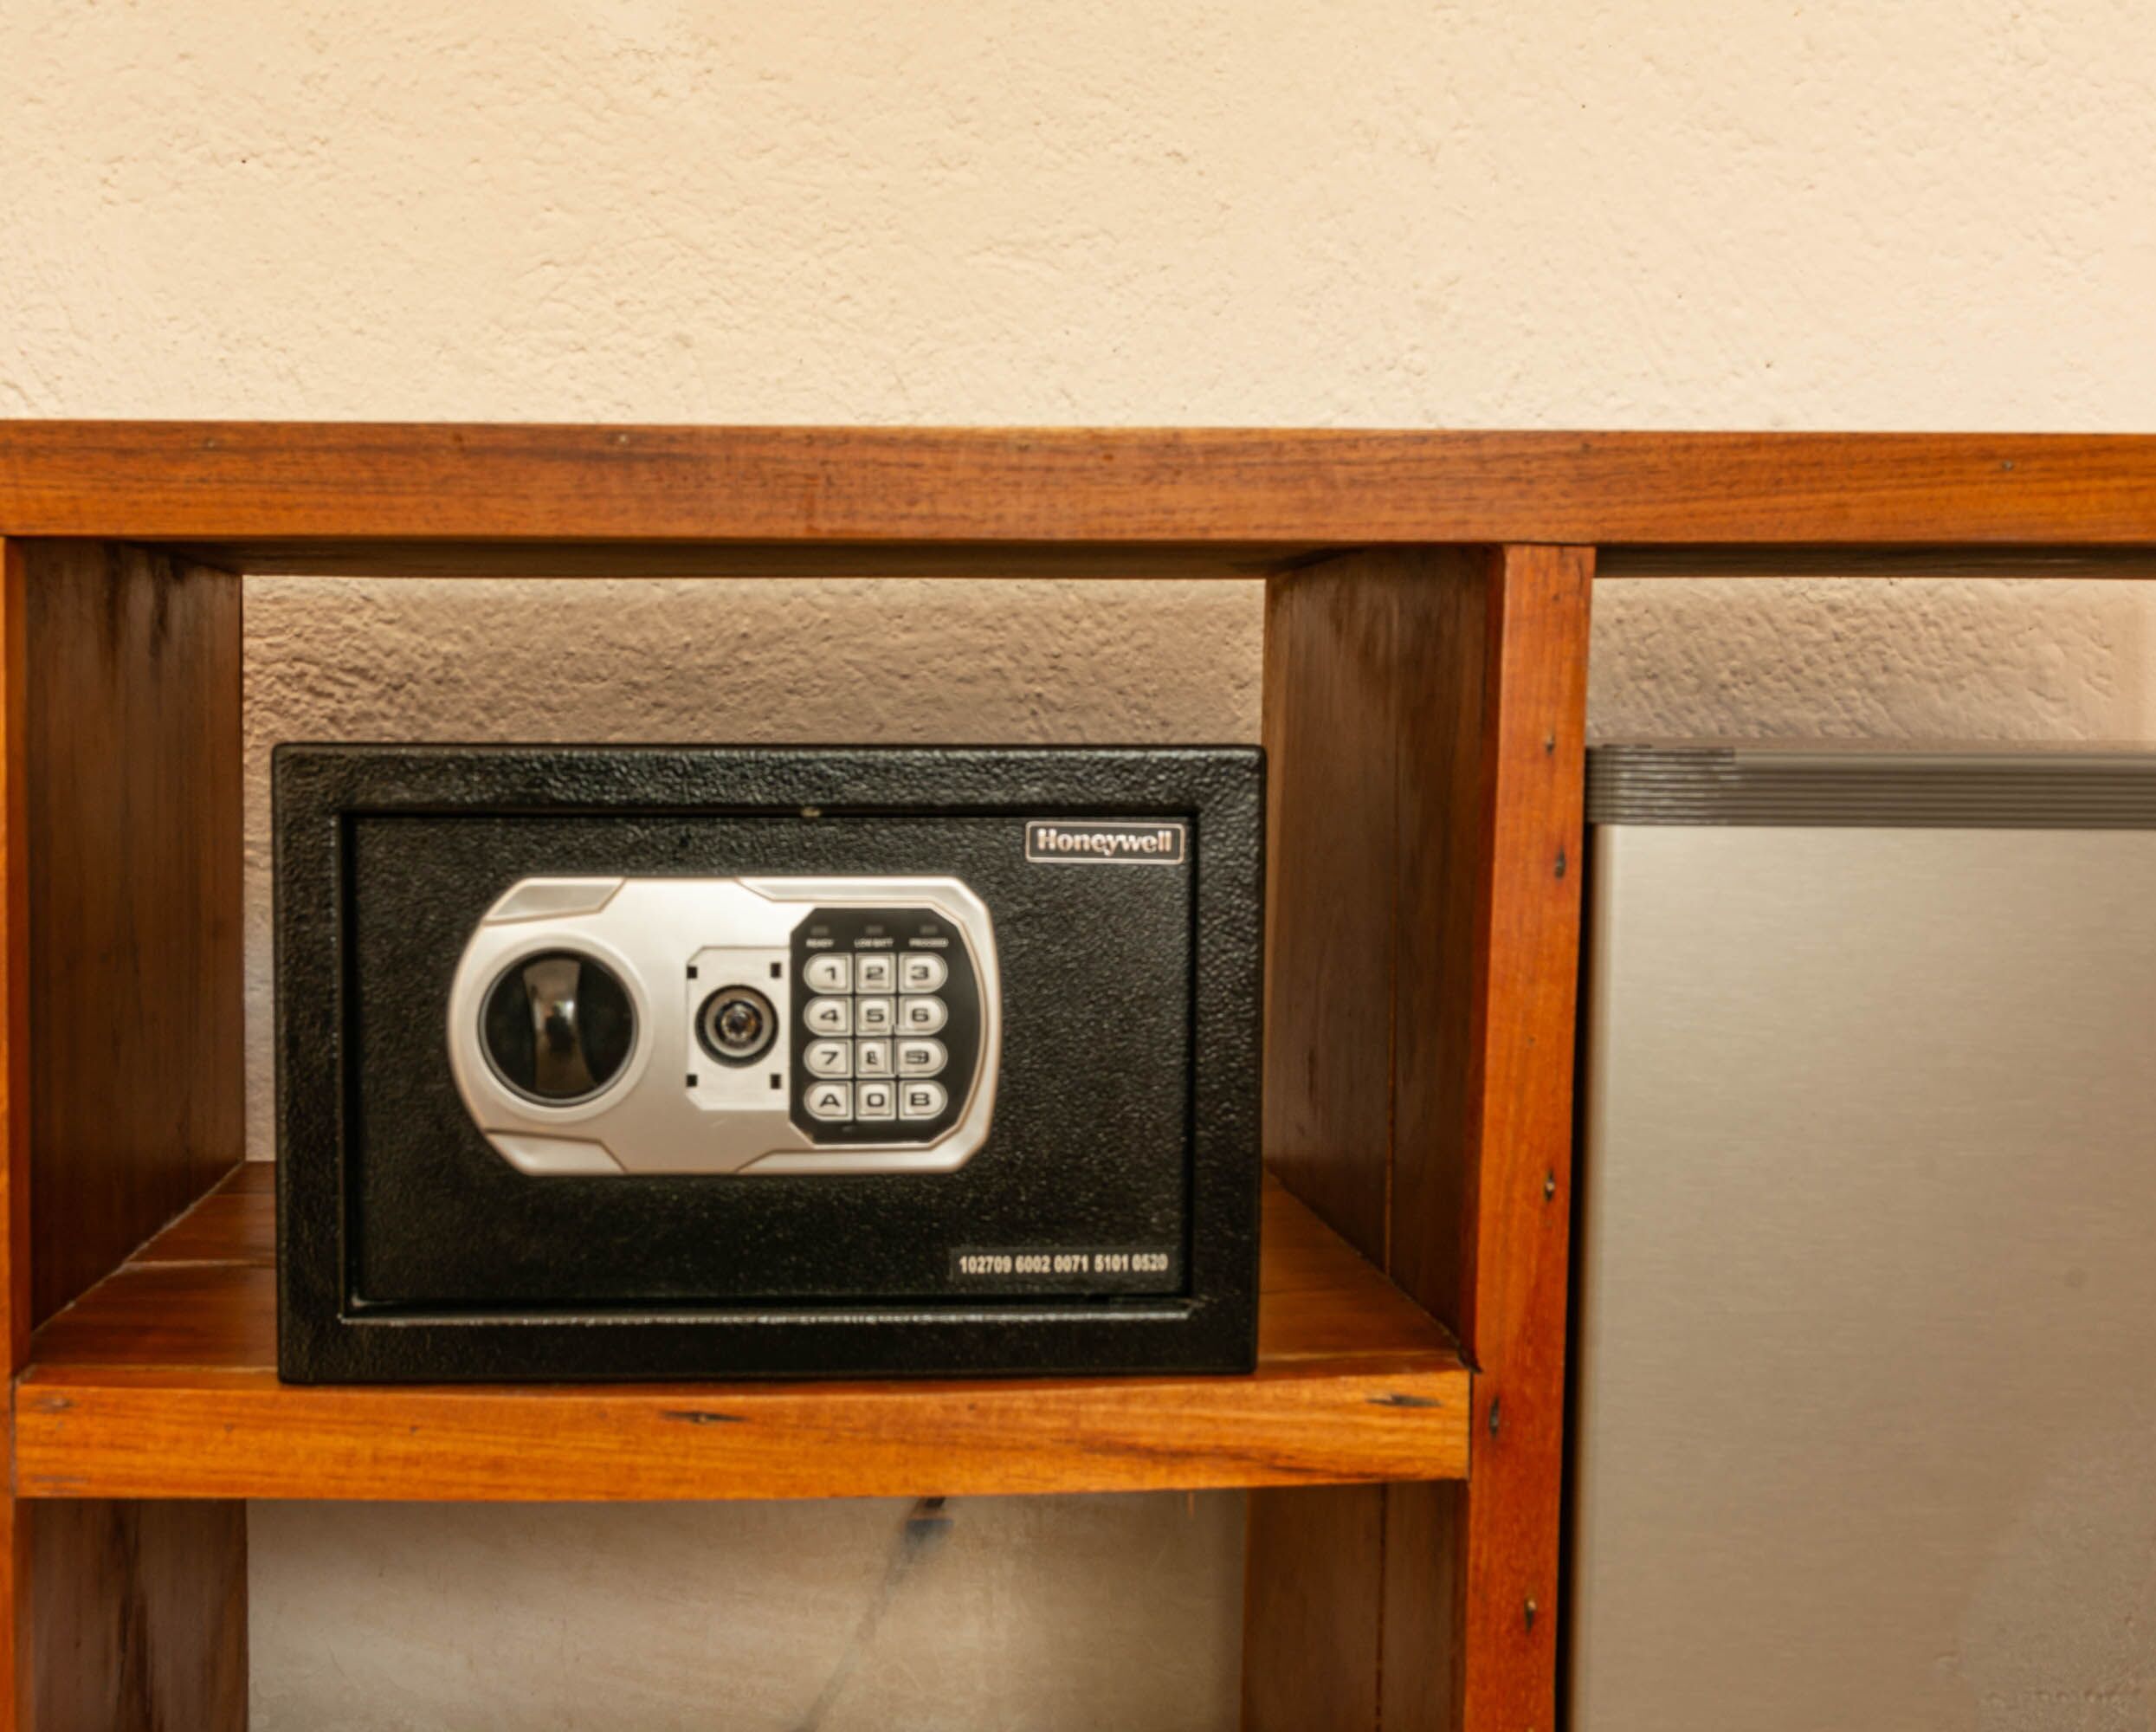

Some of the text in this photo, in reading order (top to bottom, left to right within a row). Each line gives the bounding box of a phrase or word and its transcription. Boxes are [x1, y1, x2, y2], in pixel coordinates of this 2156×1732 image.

[1036, 828, 1172, 856] Honeywell
[825, 966, 836, 980] 1
[866, 966, 883, 980] 2
[911, 966, 929, 980] 3
[820, 1009, 838, 1023] 4
[866, 1009, 884, 1023] 5
[912, 1008, 929, 1023] 6
[821, 1050, 838, 1065] 7
[820, 1094, 841, 1108] A
[911, 1092, 930, 1107] B
[959, 1256, 1011, 1274] 102709
[1016, 1256, 1050, 1273] 6002
[1054, 1255, 1088, 1273] 0071
[1094, 1254, 1129, 1272] 5101
